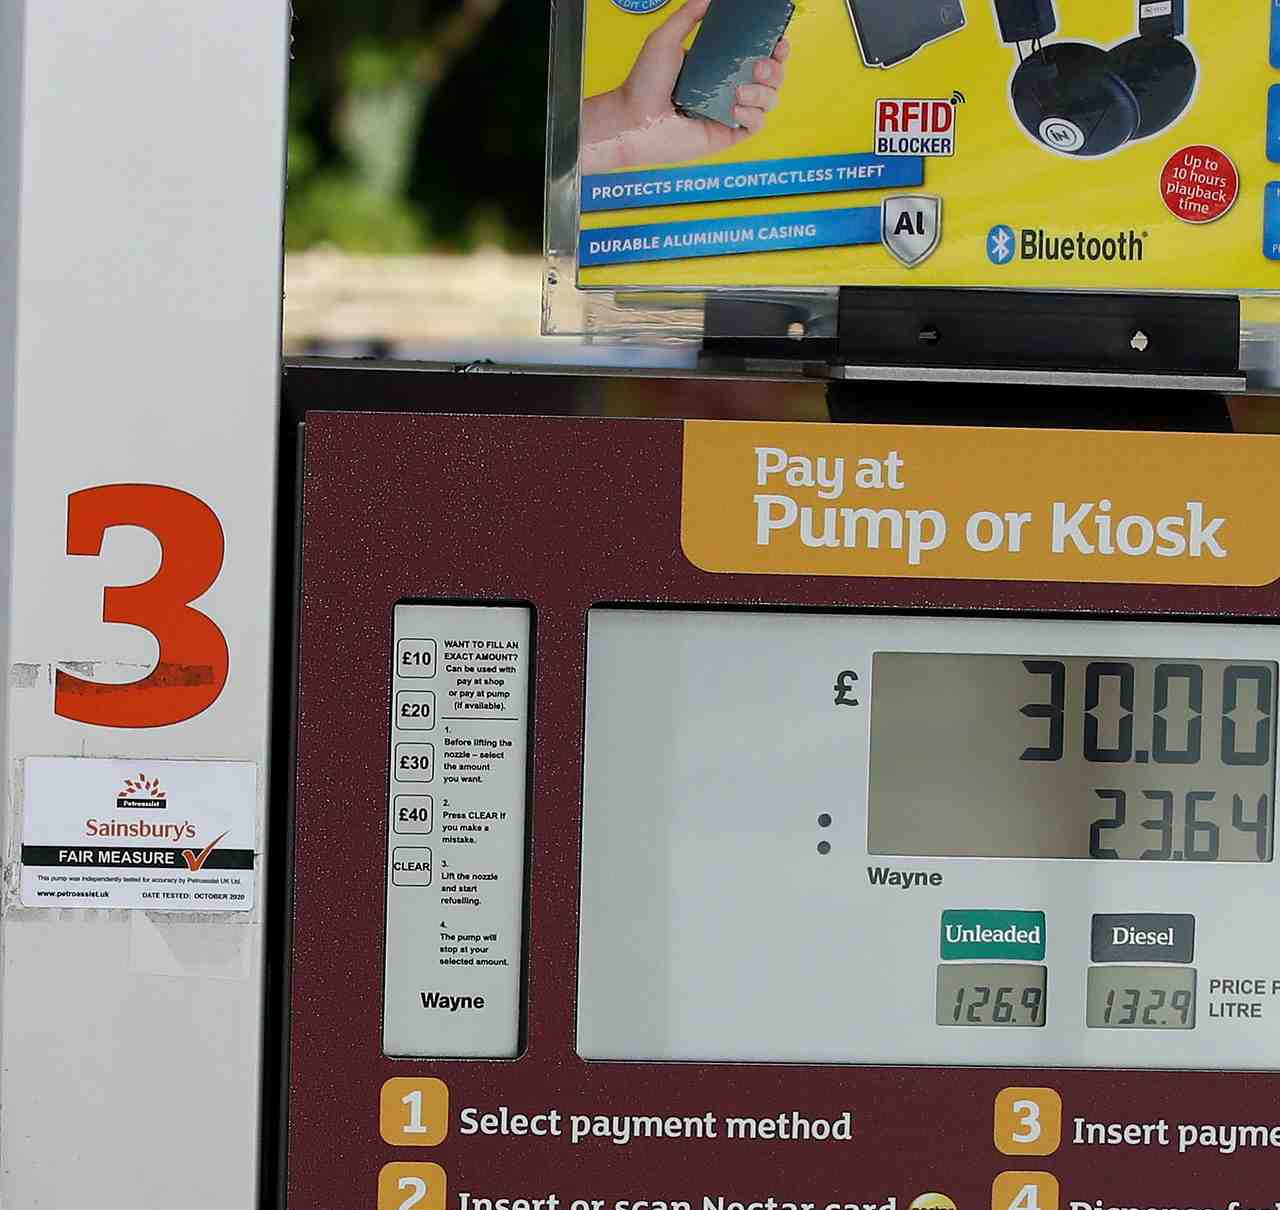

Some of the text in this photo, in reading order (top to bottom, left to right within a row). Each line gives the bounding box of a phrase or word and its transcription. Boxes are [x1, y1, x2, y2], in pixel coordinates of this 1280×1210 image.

[878, 102, 953, 133] RFID
[878, 138, 952, 153] BLOCKER
[1183, 155, 1218, 171] Up to
[592, 165, 885, 200] PROTECTS FROM CONTACTLESS THEFT
[1172, 167, 1227, 188] 10 hours
[1167, 182, 1227, 203] playback
[1178, 198, 1209, 215] time
[589, 224, 816, 254] DURABLE ALUMINIUM CASING
[1020, 229, 1143, 262] Bluetooth
[754, 447, 905, 499] Pay at
[753, 493, 1228, 565] Pump or Kiosk
[54, 483, 230, 729] 3
[444, 640, 519, 649] WANT TO FILL AN
[402, 652, 431, 666] £10
[444, 653, 518, 662] EXACT AMOUNT?
[833, 670, 859, 707] £
[401, 703, 430, 718] £20
[1018, 660, 1273, 766] 30.00
[400, 755, 429, 770] £30
[399, 808, 428, 822] £40
[1089, 789, 1268, 862] 23.64
[85, 819, 196, 842] Sainsbury's
[59, 850, 175, 865] FAIR MEASURE
[394, 862, 430, 872] CLEAR
[867, 867, 943, 889] Wayne
[945, 924, 1041, 945] Unleaded
[1111, 927, 1174, 946] Diesel
[1209, 979, 1266, 995] PRICE
[420, 992, 485, 1011] Wayne
[951, 986, 1042, 1024] 126.9
[1103, 988, 1192, 1026] 132.9
[1208, 1003, 1263, 1019] LITRE
[400, 1090, 853, 1145] 1 Select payment method
[1011, 1101, 1041, 1143] 3
[1072, 1118, 1169, 1146] Insert
